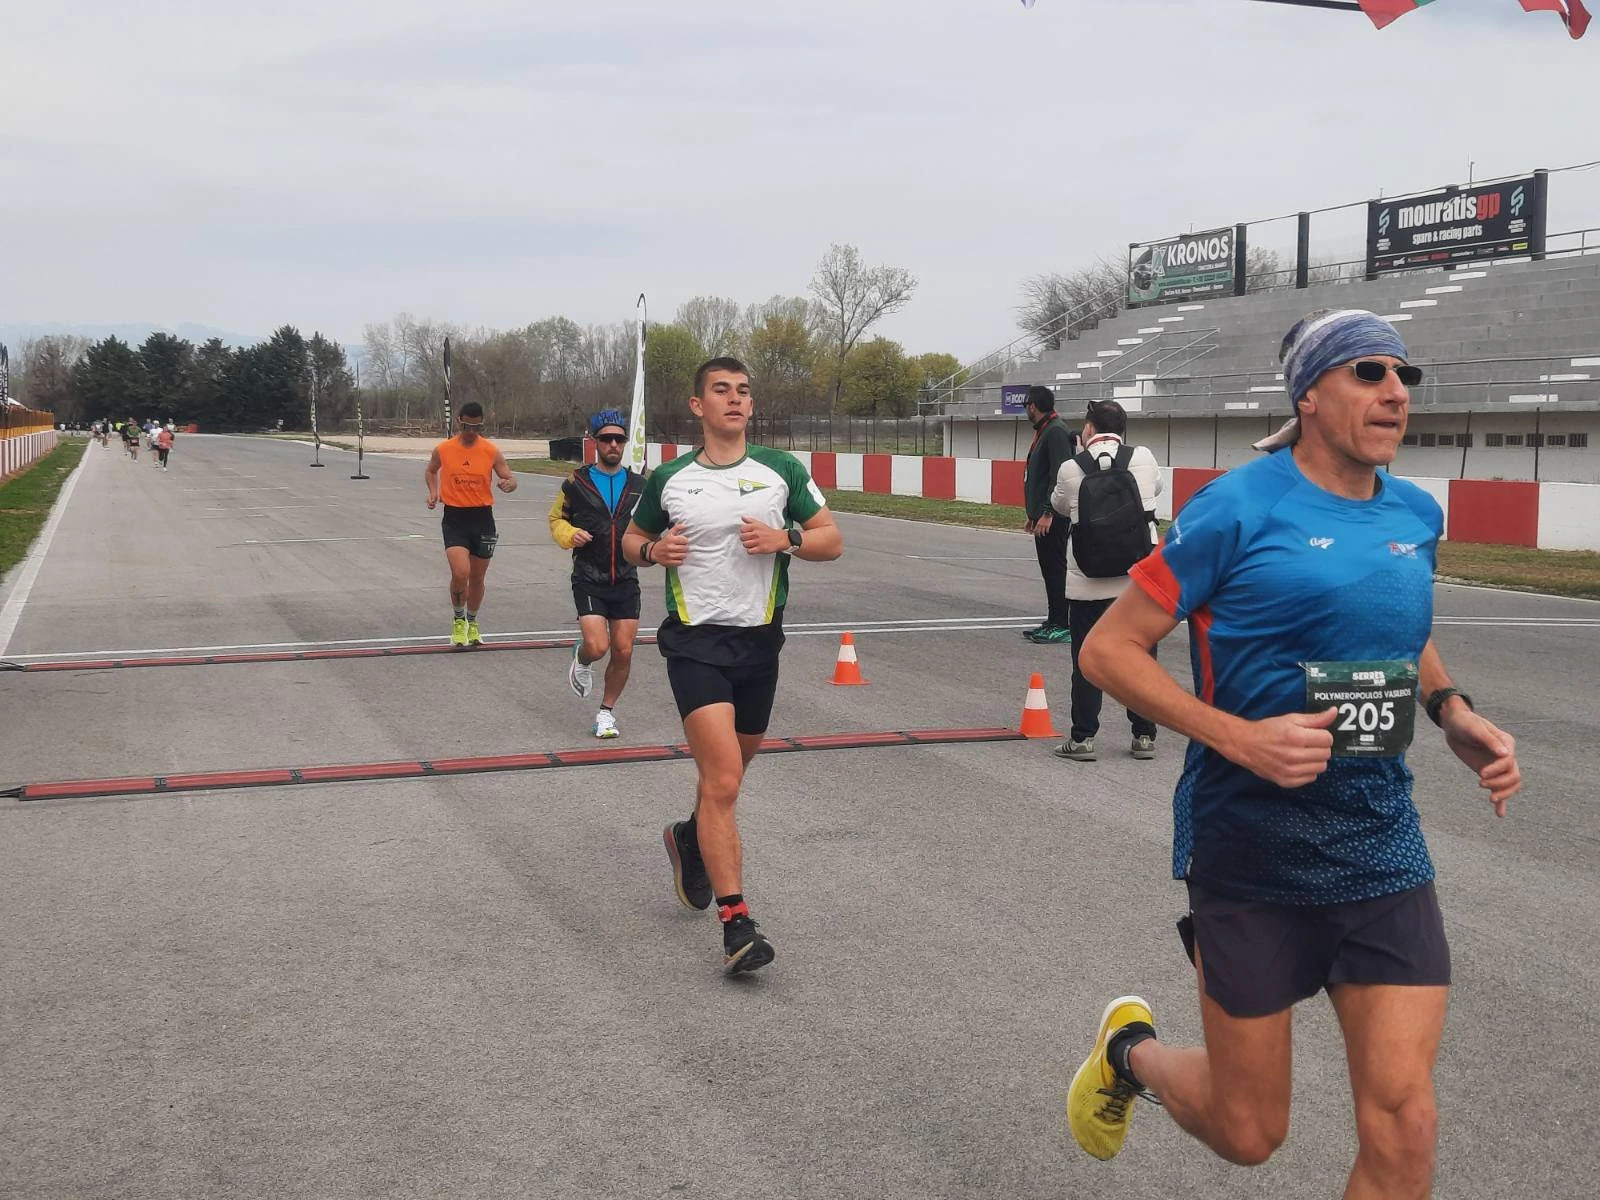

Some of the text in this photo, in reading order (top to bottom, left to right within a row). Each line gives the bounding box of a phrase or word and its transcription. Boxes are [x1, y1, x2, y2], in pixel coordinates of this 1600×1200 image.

[1398, 192, 1500, 229] mouratisgp
[1412, 224, 1483, 245] spare & racing parts
[1167, 235, 1229, 267] KRONOS
[1337, 701, 1395, 732] 205
